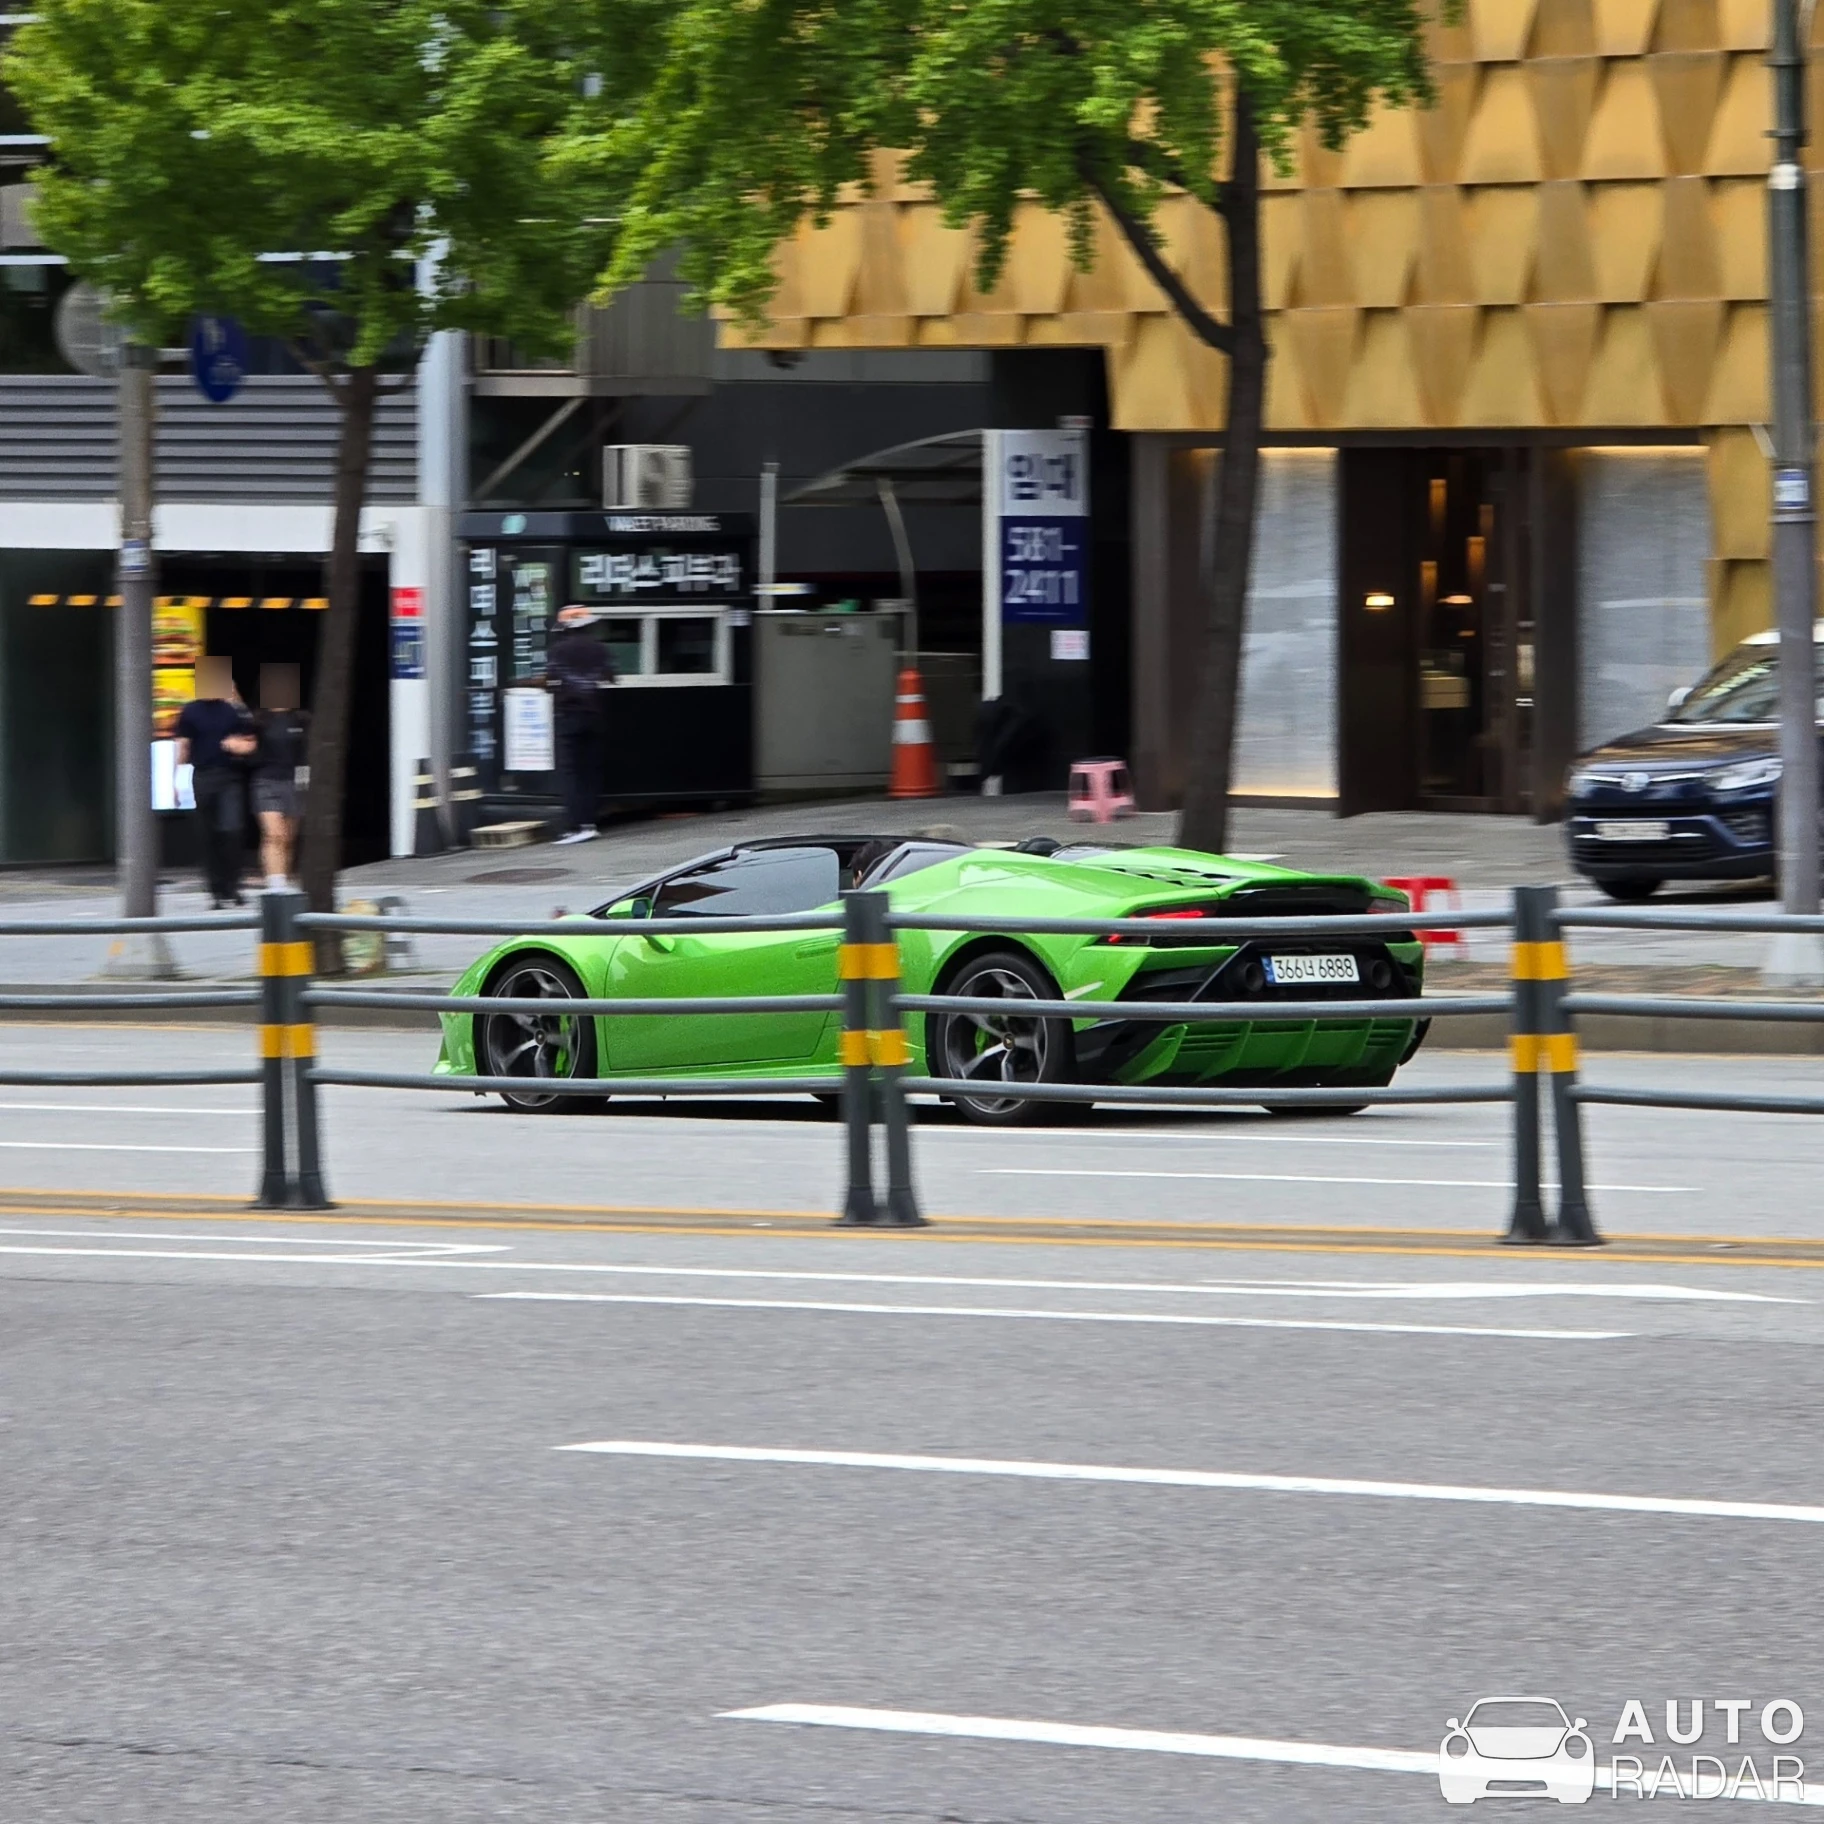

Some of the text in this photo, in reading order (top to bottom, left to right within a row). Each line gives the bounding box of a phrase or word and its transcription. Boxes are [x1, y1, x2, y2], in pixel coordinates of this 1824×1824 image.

[1007, 453, 1080, 500] 임대
[1008, 527, 1079, 562] 581-
[580, 554, 742, 592] 리더스피부과
[1004, 570, 1079, 604] 2411
[1274, 959, 1315, 979] 366너
[1319, 958, 1354, 978] 6888
